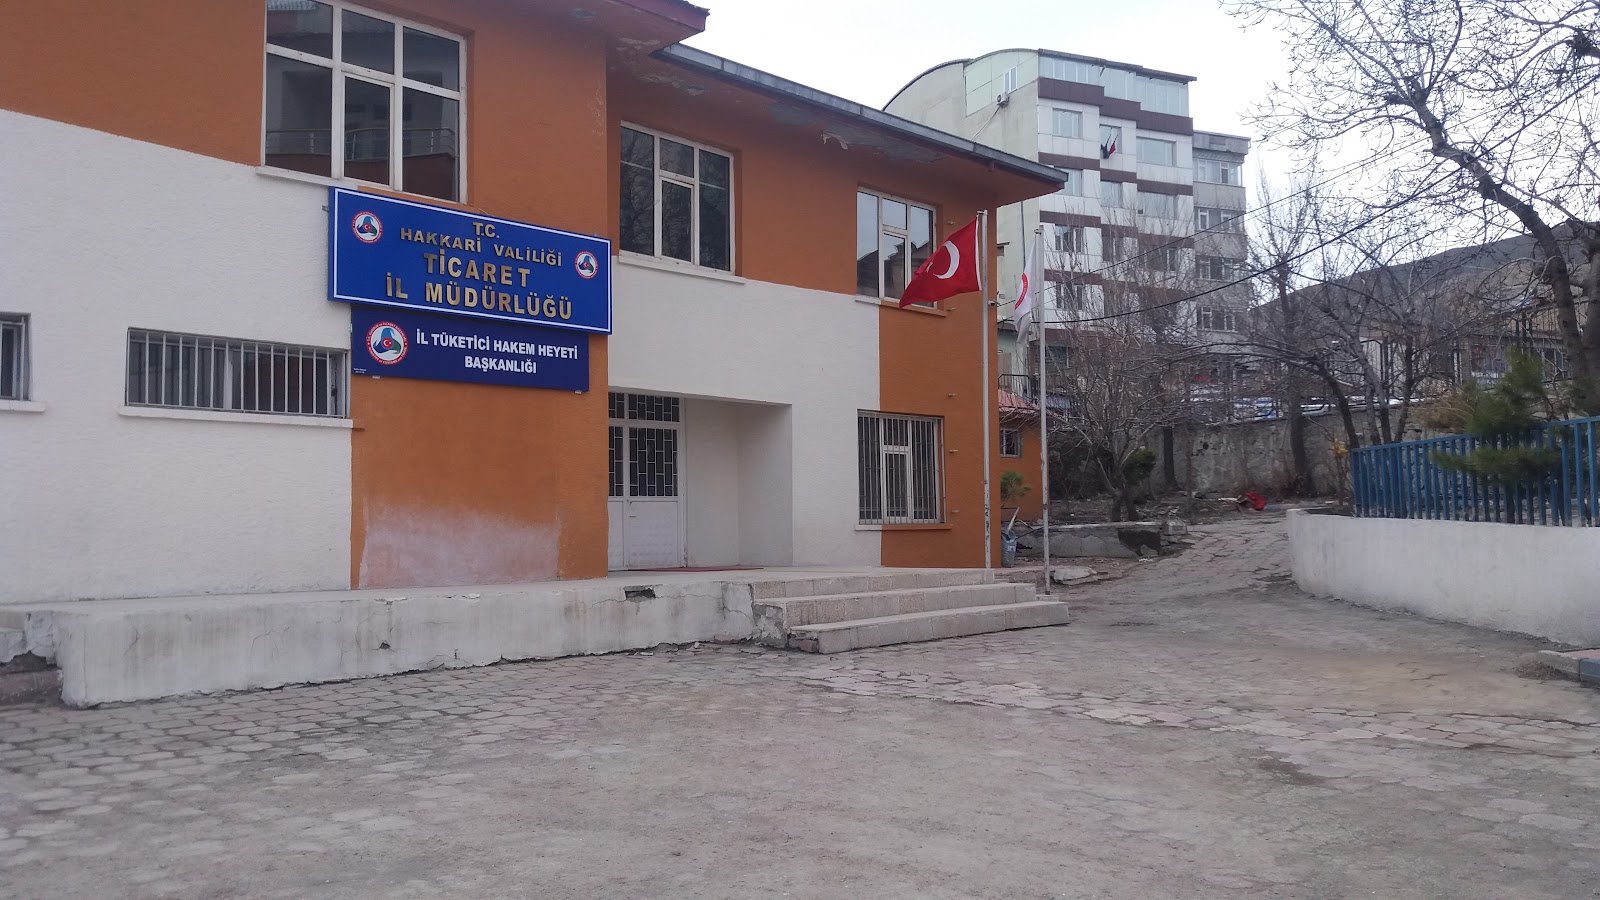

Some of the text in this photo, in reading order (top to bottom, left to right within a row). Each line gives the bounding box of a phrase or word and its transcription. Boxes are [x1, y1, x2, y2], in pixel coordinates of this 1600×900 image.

[472, 221, 500, 238] T.C.
[400, 227, 482, 253] HAKKARİ
[494, 243, 563, 267] VALİLİĞİ
[424, 249, 531, 287] TİCARET
[386, 272, 573, 319] İL MÜDÜRLÜĞÜ
[416, 328, 578, 359] İL TÜKETİCİ HAKEM HEYETİ
[464, 355, 537, 374] BAŞKANLIĞI
